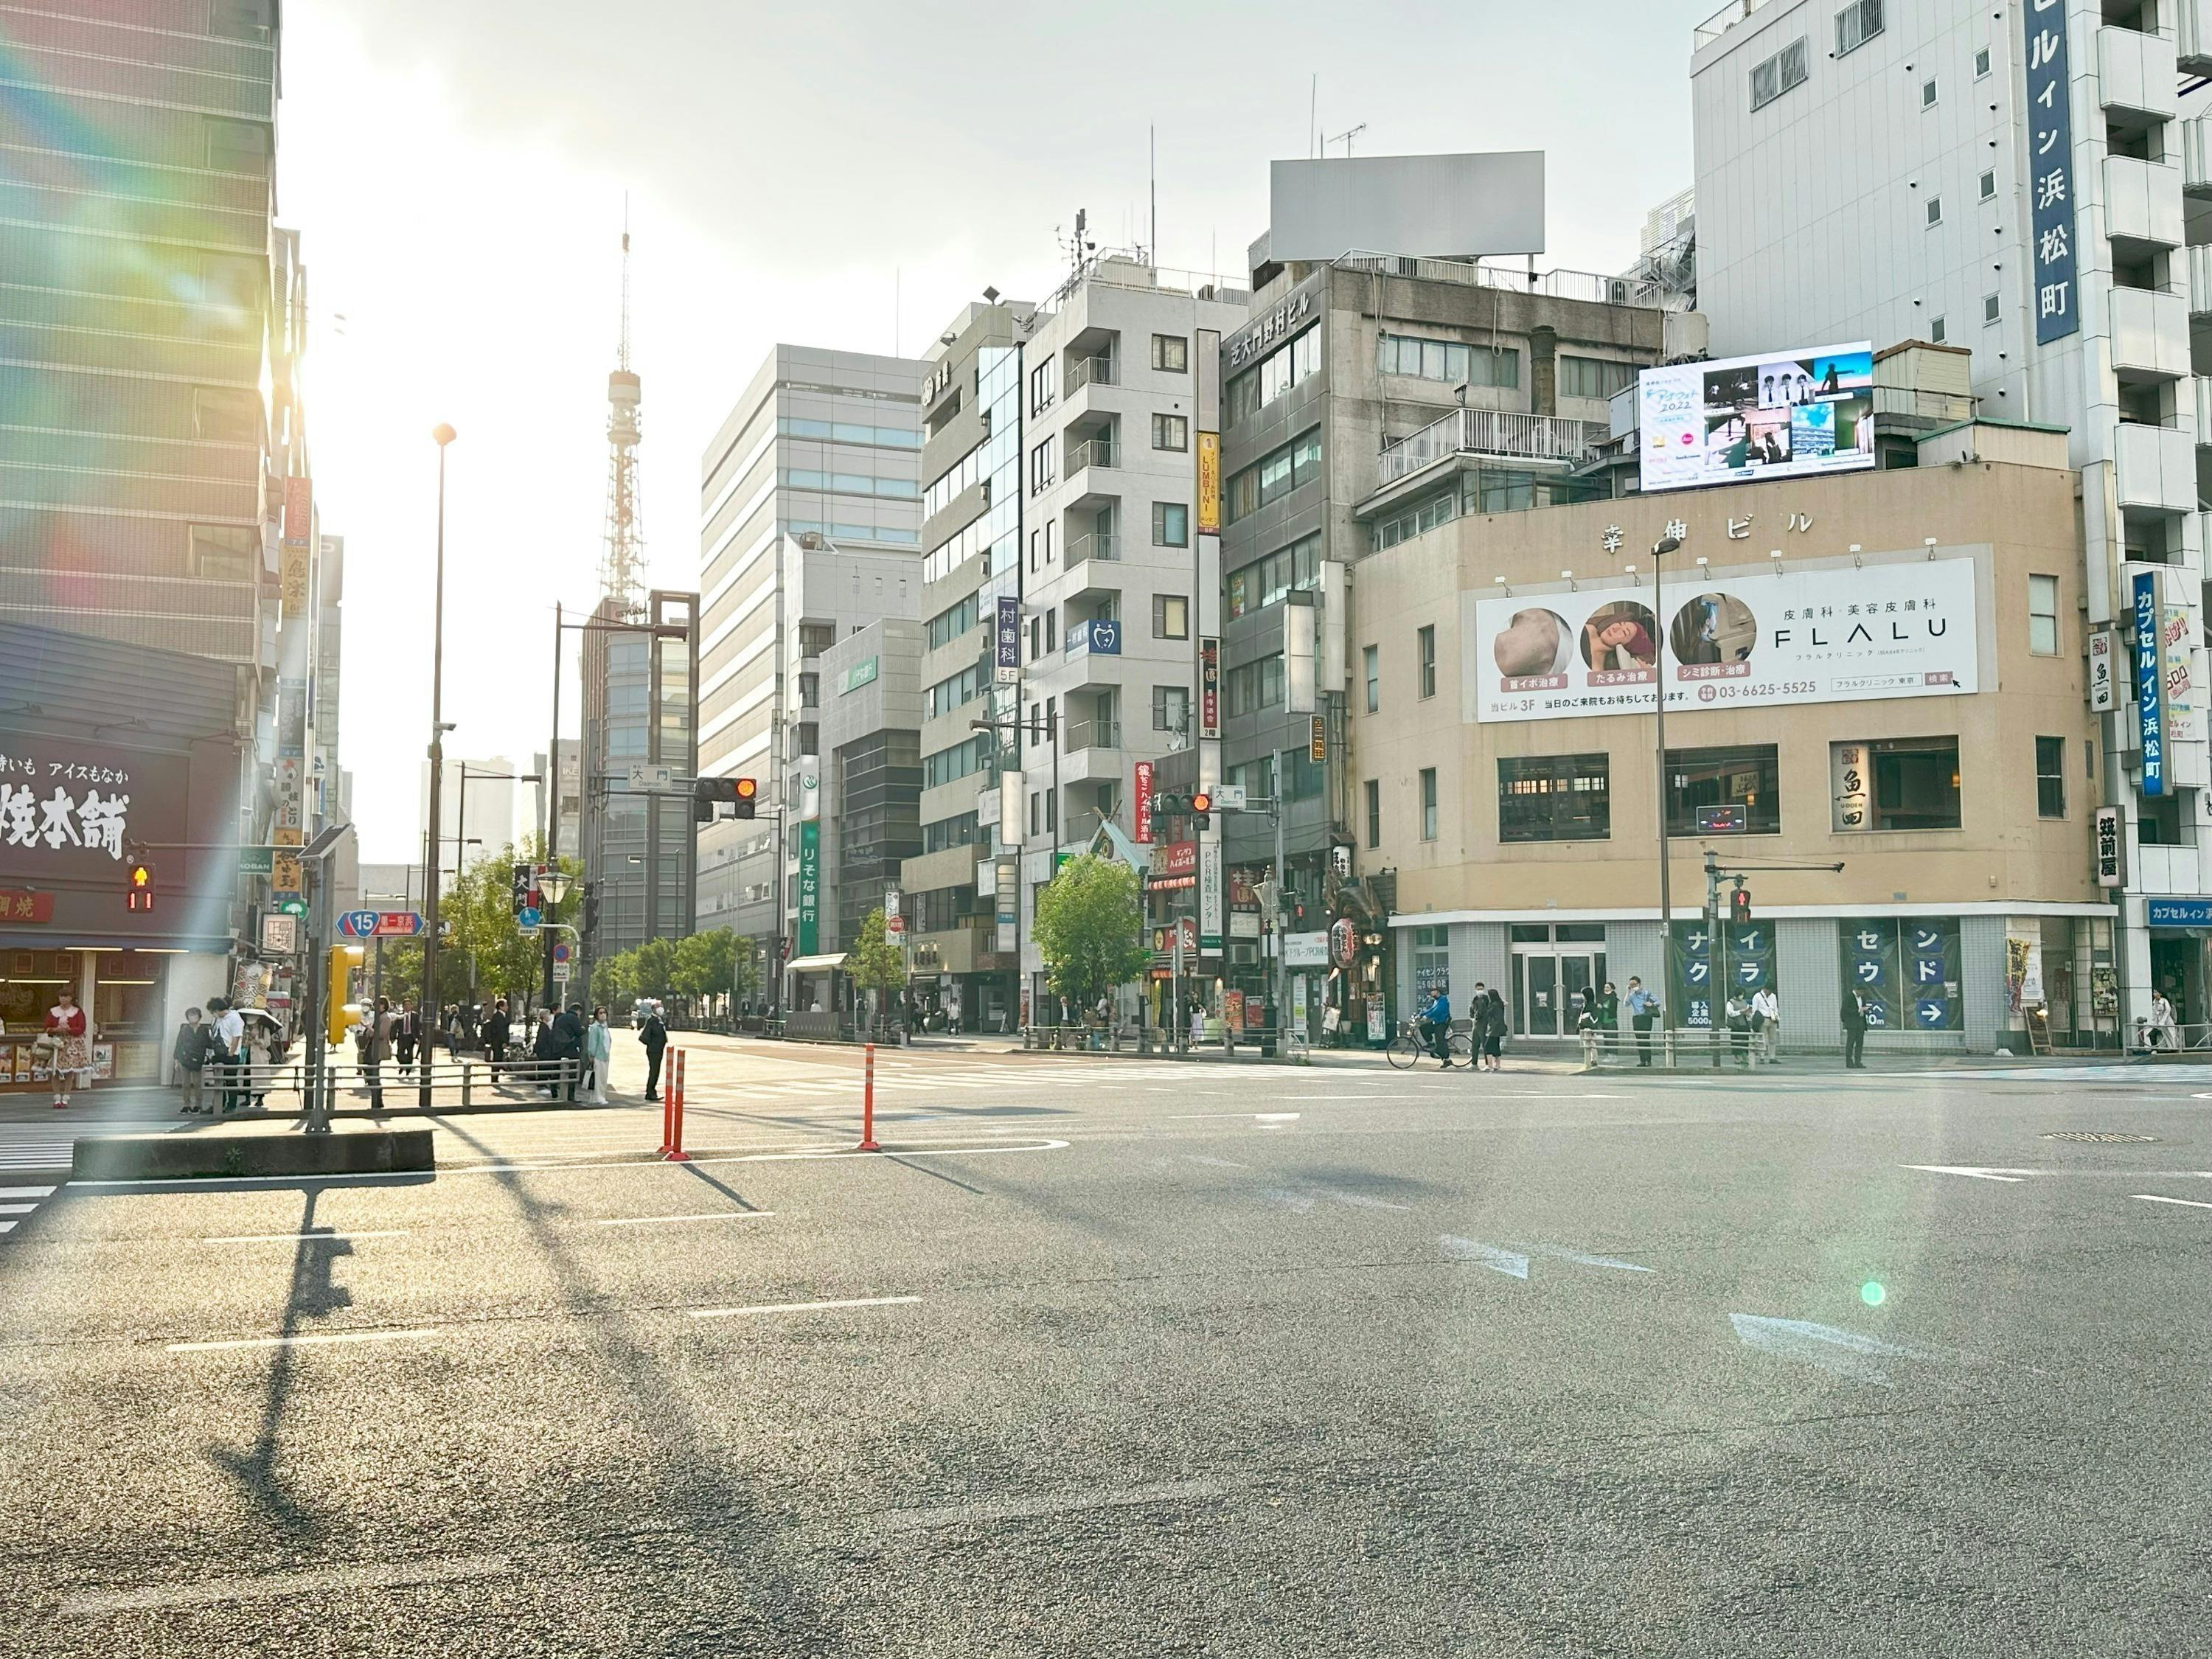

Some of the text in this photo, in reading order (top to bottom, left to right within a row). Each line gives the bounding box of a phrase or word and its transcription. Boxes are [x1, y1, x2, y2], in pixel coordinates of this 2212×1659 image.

[1231, 292, 1310, 367] 芝大門野村ビル
[1660, 400, 1692, 413] 2022
[1601, 513, 1813, 554] 幸伸ビル
[1783, 598, 1936, 620] 皮膚科・美容皮膚科
[1001, 599, 1016, 663] 一村歯科
[1775, 618, 1947, 649] FLALU
[1795, 649, 1874, 662] フラルクリニック
[1001, 670, 1016, 681] 5F
[1596, 672, 1648, 684] たるみ治療
[1682, 664, 1746, 678] シミ診断・治療
[1509, 678, 1559, 690] 首イボ治療
[1719, 681, 1817, 699] 03-6625-5525
[1835, 676, 1915, 689] フラルクリニック 東京
[2138, 591, 2160, 779] カプセルイン浜松町
[1490, 699, 1536, 713] 当ビル 3F
[49, 762, 129, 785] アイスもなか
[632, 769, 668, 781] 大門
[1215, 789, 1243, 800] 大門
[2100, 816, 2117, 877] 筑前屋
[514, 874, 529, 907] 大門
[802, 847, 816, 922] りそな銀行
[355, 914, 374, 931] 15
[1416, 967, 1450, 977] ナイセンクラウ
